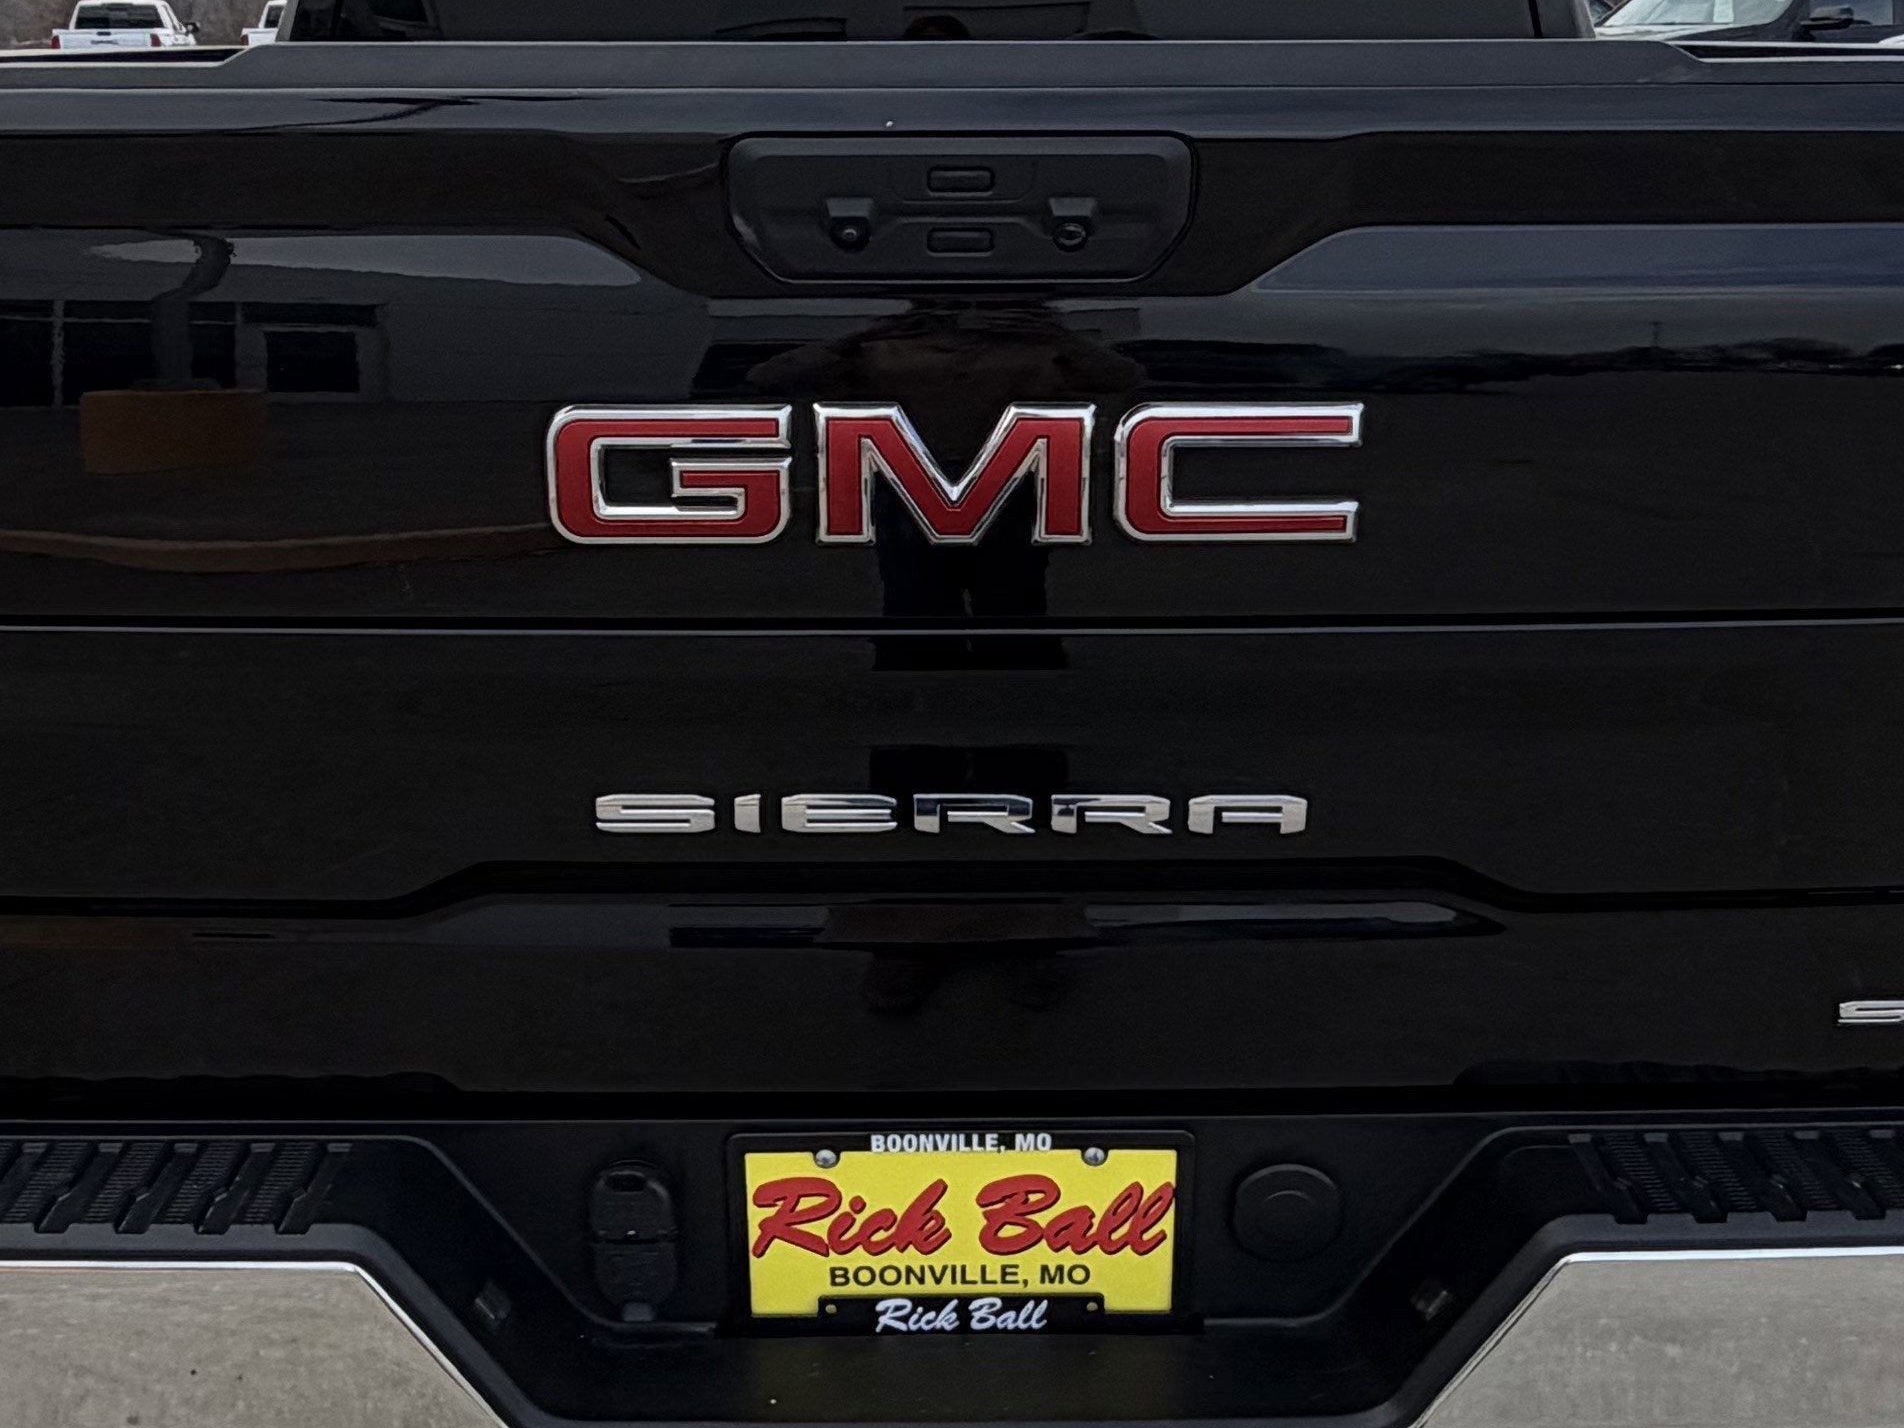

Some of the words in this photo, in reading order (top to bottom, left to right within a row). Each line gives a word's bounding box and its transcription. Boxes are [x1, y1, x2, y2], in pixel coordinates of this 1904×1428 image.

[546, 402, 1365, 546] GMC
[594, 791, 1309, 836] SIERRA
[870, 1133, 1007, 1154] BOONVILLE,
[1015, 1133, 1052, 1152] MO
[752, 1176, 953, 1258] Rick
[975, 1174, 1176, 1257] Ball
[829, 1265, 1030, 1290] BOONVILLE,
[1039, 1264, 1092, 1286] MO
[874, 1298, 961, 1333] Rick
[969, 1297, 1048, 1332] Ball
